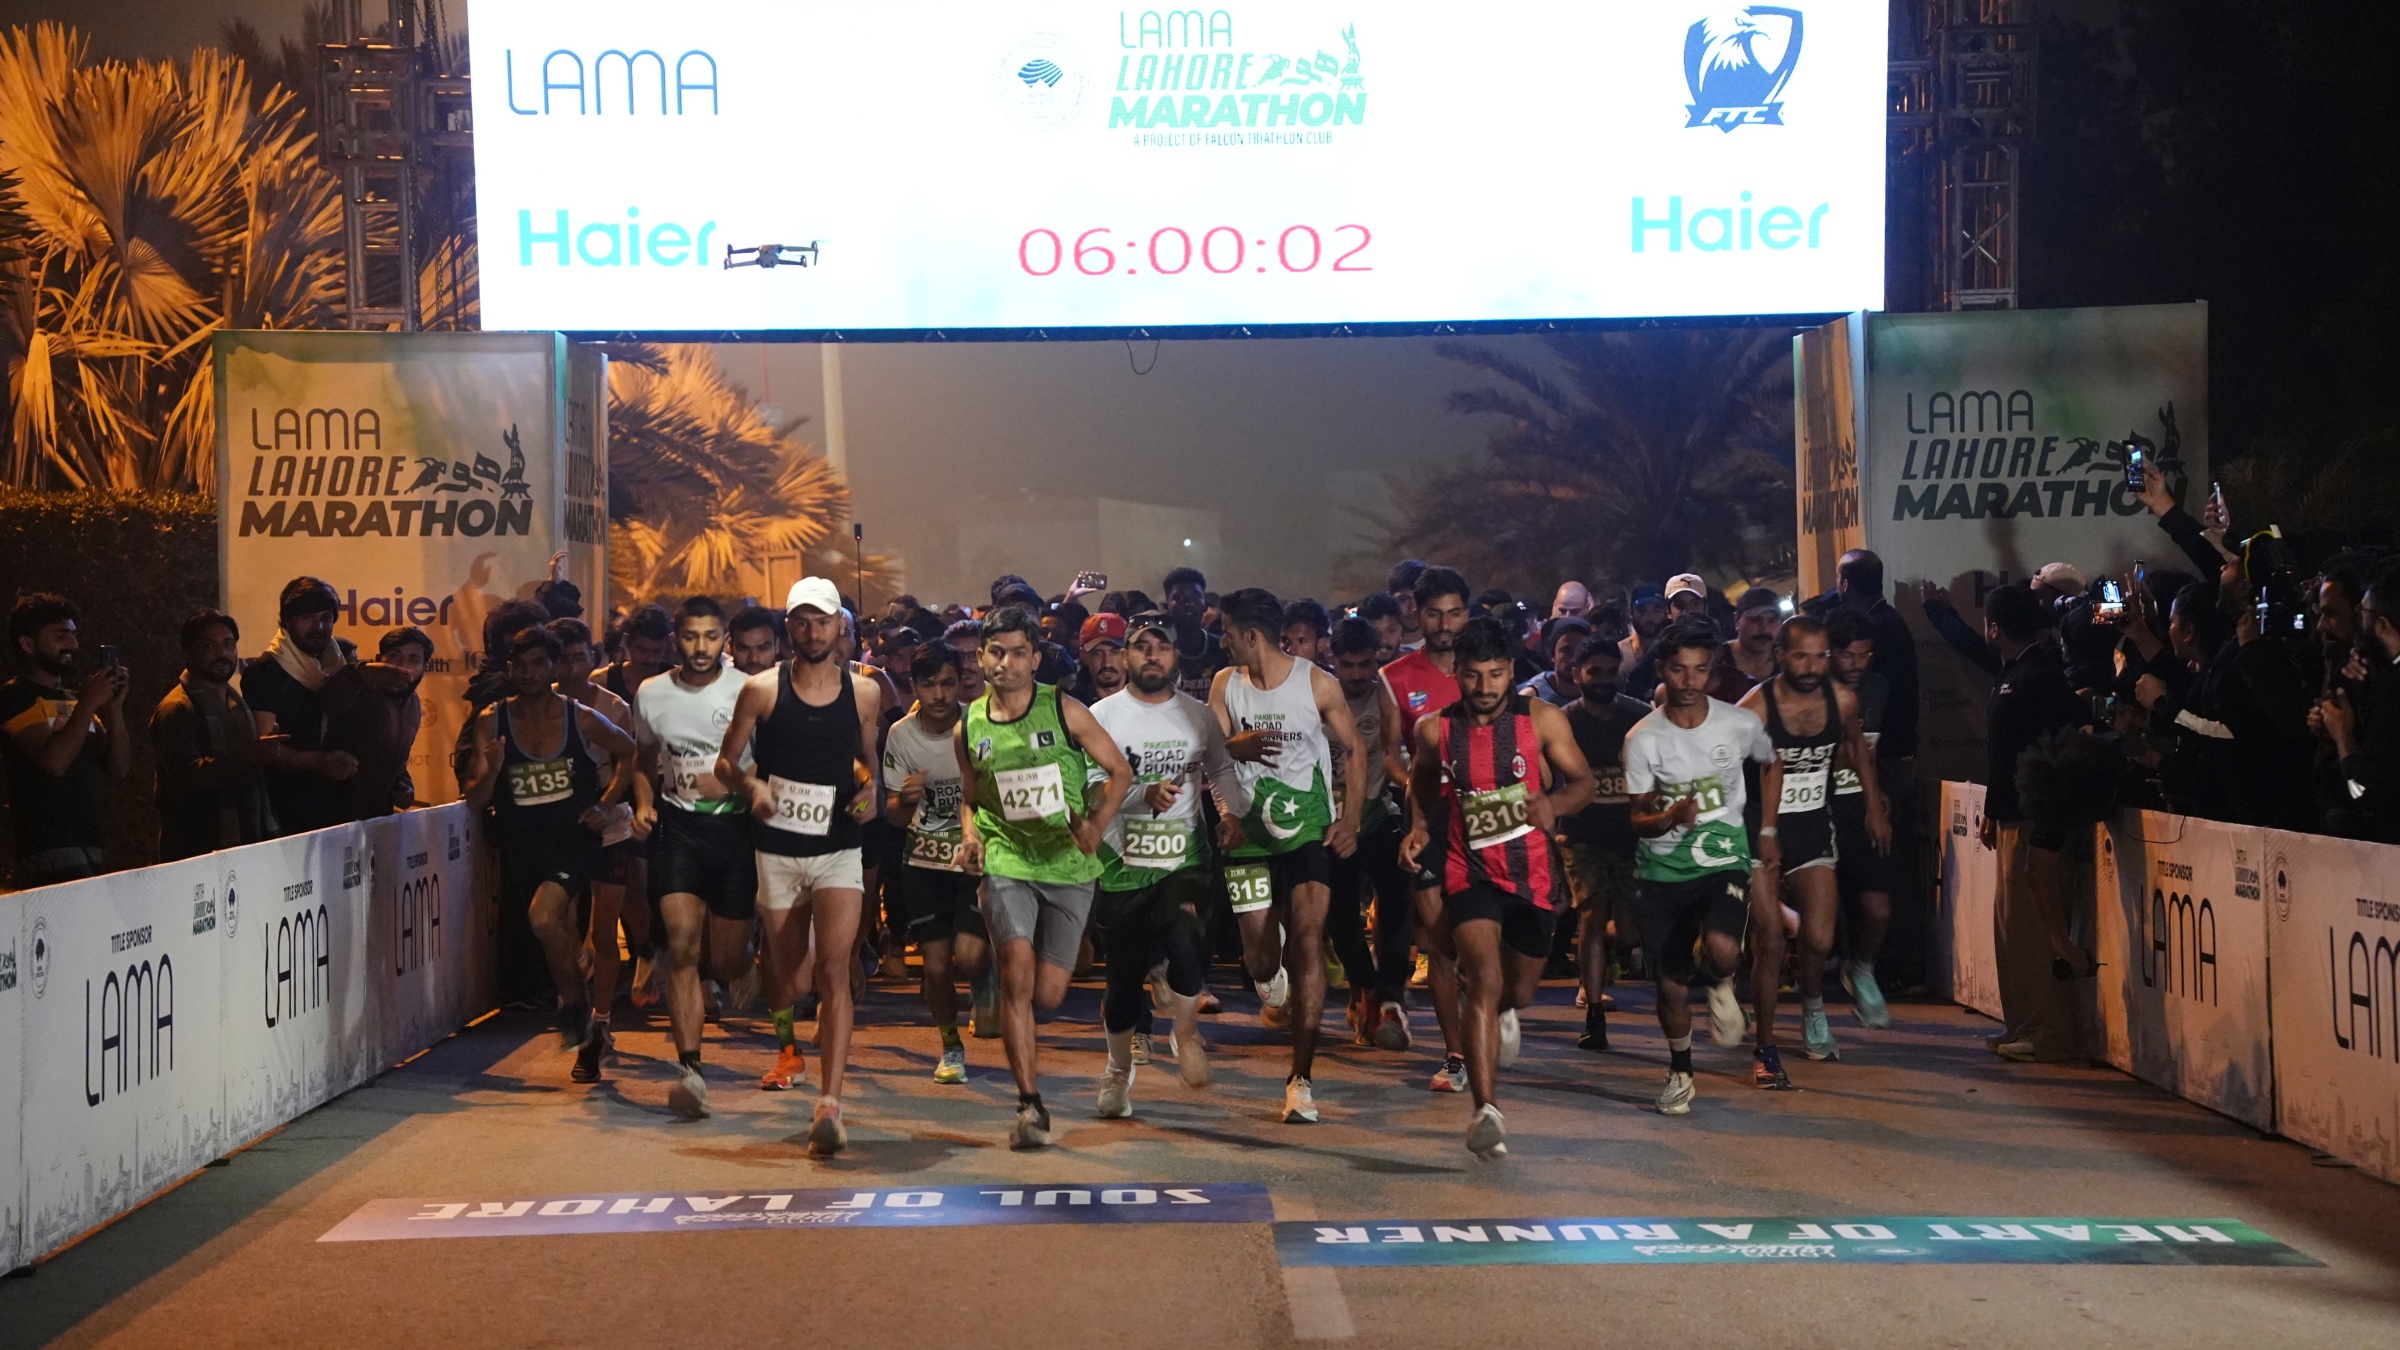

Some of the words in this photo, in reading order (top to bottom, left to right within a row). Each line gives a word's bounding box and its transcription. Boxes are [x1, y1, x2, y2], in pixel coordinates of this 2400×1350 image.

[1120, 9, 1232, 49] LAMA
[506, 49, 718, 115] LAMA
[1116, 53, 1255, 91] LAHORE
[1108, 92, 1367, 129] MARATHON
[1701, 106, 1769, 123] FTC
[1133, 134, 1140, 146] A
[1143, 133, 1185, 146] PROJECT
[1189, 133, 1201, 146] OF
[1205, 132, 1244, 146] FALCON
[1248, 131, 1303, 145] TRIATHLON
[1306, 131, 1332, 144] CLUB
[1632, 190, 1829, 253] Haier
[518, 206, 716, 267] Haier
[1019, 225, 1373, 276] 06:00:02
[1907, 389, 2034, 434] LAMA
[252, 408, 381, 451] LAMA
[1901, 436, 2059, 481] LAHORE
[248, 455, 406, 497] LAHORE
[238, 500, 534, 538] MARATHON
[1254, 721, 1282, 731] ROAD
[1143, 749, 1185, 763] ROAD
[511, 769, 570, 795] 2135
[677, 773, 700, 790] 42
[936, 785, 962, 797] ROA
[1003, 782, 1060, 809] 4271
[773, 794, 829, 824] 360
[1126, 833, 1186, 855] 2500
[2169, 863, 2193, 882] SPONSOR
[283, 884, 294, 903] TITLE
[294, 879, 313, 899] SPONSOR
[1227, 877, 1270, 902] 315
[2356, 898, 2373, 919] TITLE
[393, 872, 441, 977] LAMA
[111, 932, 126, 954] TITLE
[126, 924, 153, 949] SPONSOR
[2140, 884, 2218, 1008] LAMA
[265, 903, 330, 1029] LAMA
[85, 953, 173, 1108] LAMA
[407, 1194, 793, 1220] LAHORE
[825, 1191, 944, 1210] OF
[980, 1188, 1211, 1206] SOUL
[1313, 1223, 1681, 1244] RUNNER
[1697, 1223, 1754, 1240] A
[1788, 1223, 1898, 1240] OF
[1927, 1224, 2236, 1242] HEART
